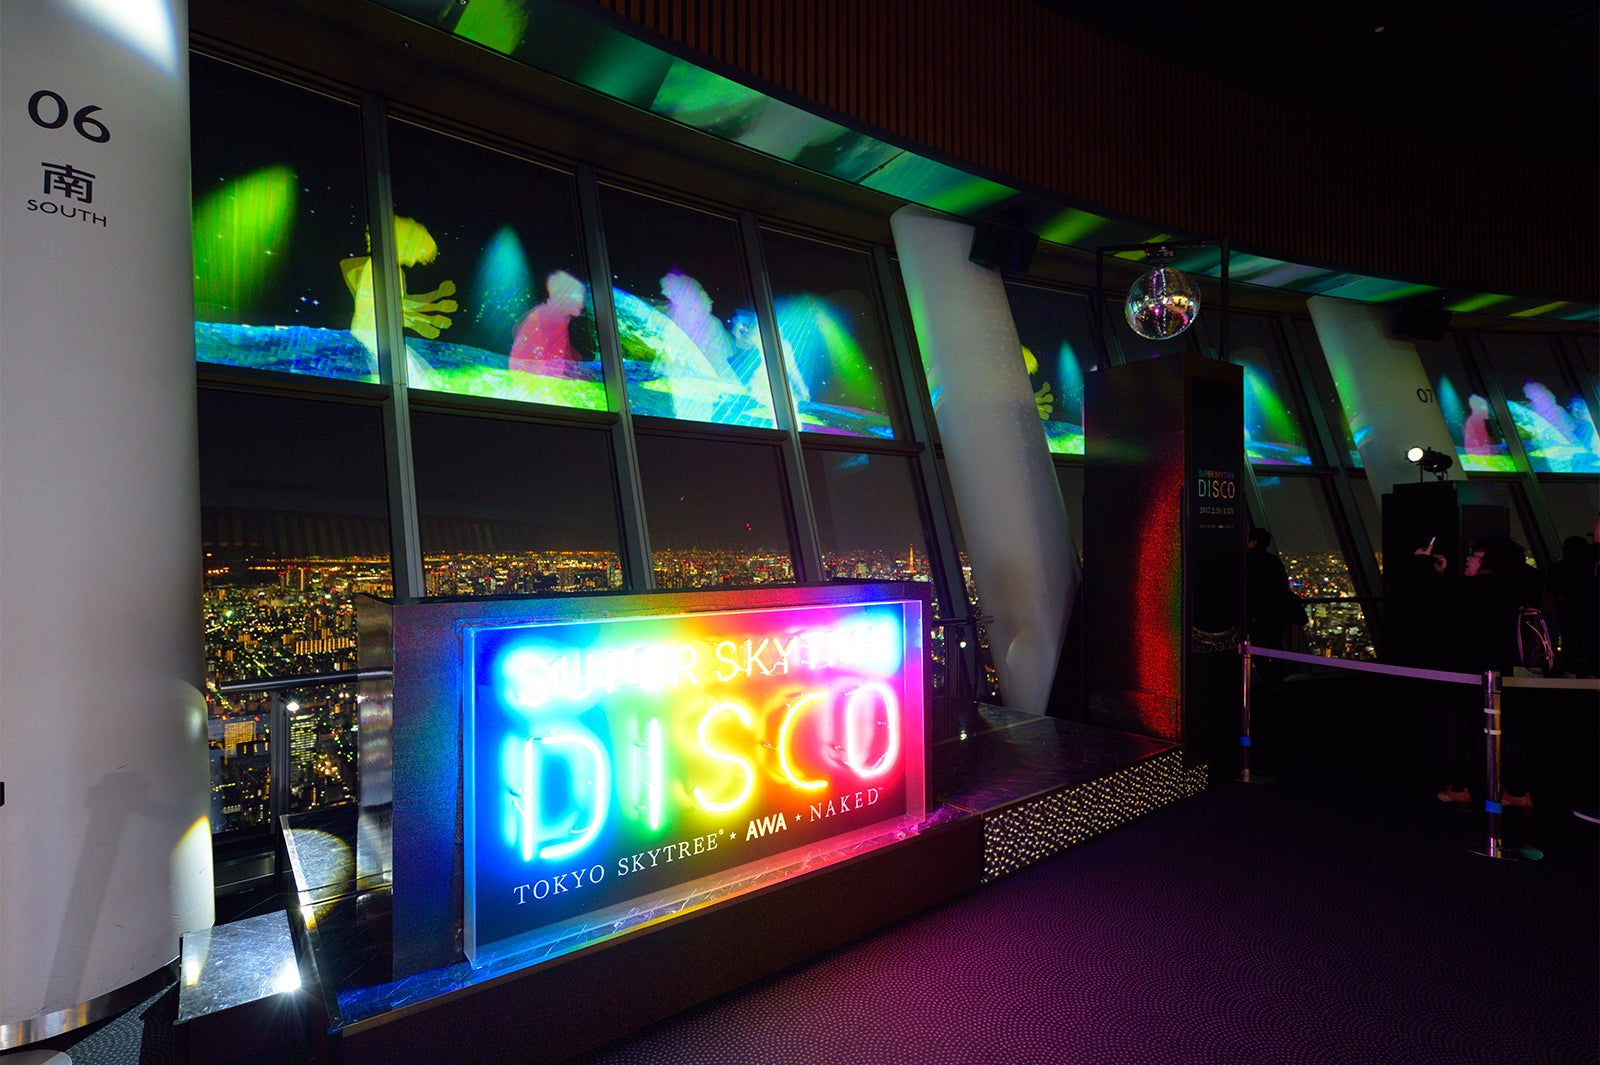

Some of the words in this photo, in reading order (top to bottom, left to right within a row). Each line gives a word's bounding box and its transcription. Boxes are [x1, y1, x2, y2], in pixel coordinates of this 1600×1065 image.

[28, 89, 111, 144] 06
[41, 161, 96, 204] 南
[27, 199, 107, 227] SOUTH
[1416, 387, 1433, 403] 07
[1198, 478, 1236, 499] DISCO
[714, 621, 891, 683] SKYT
[521, 681, 899, 863] DISCO
[513, 864, 605, 905] TOKYO
[745, 812, 788, 842] AWA
